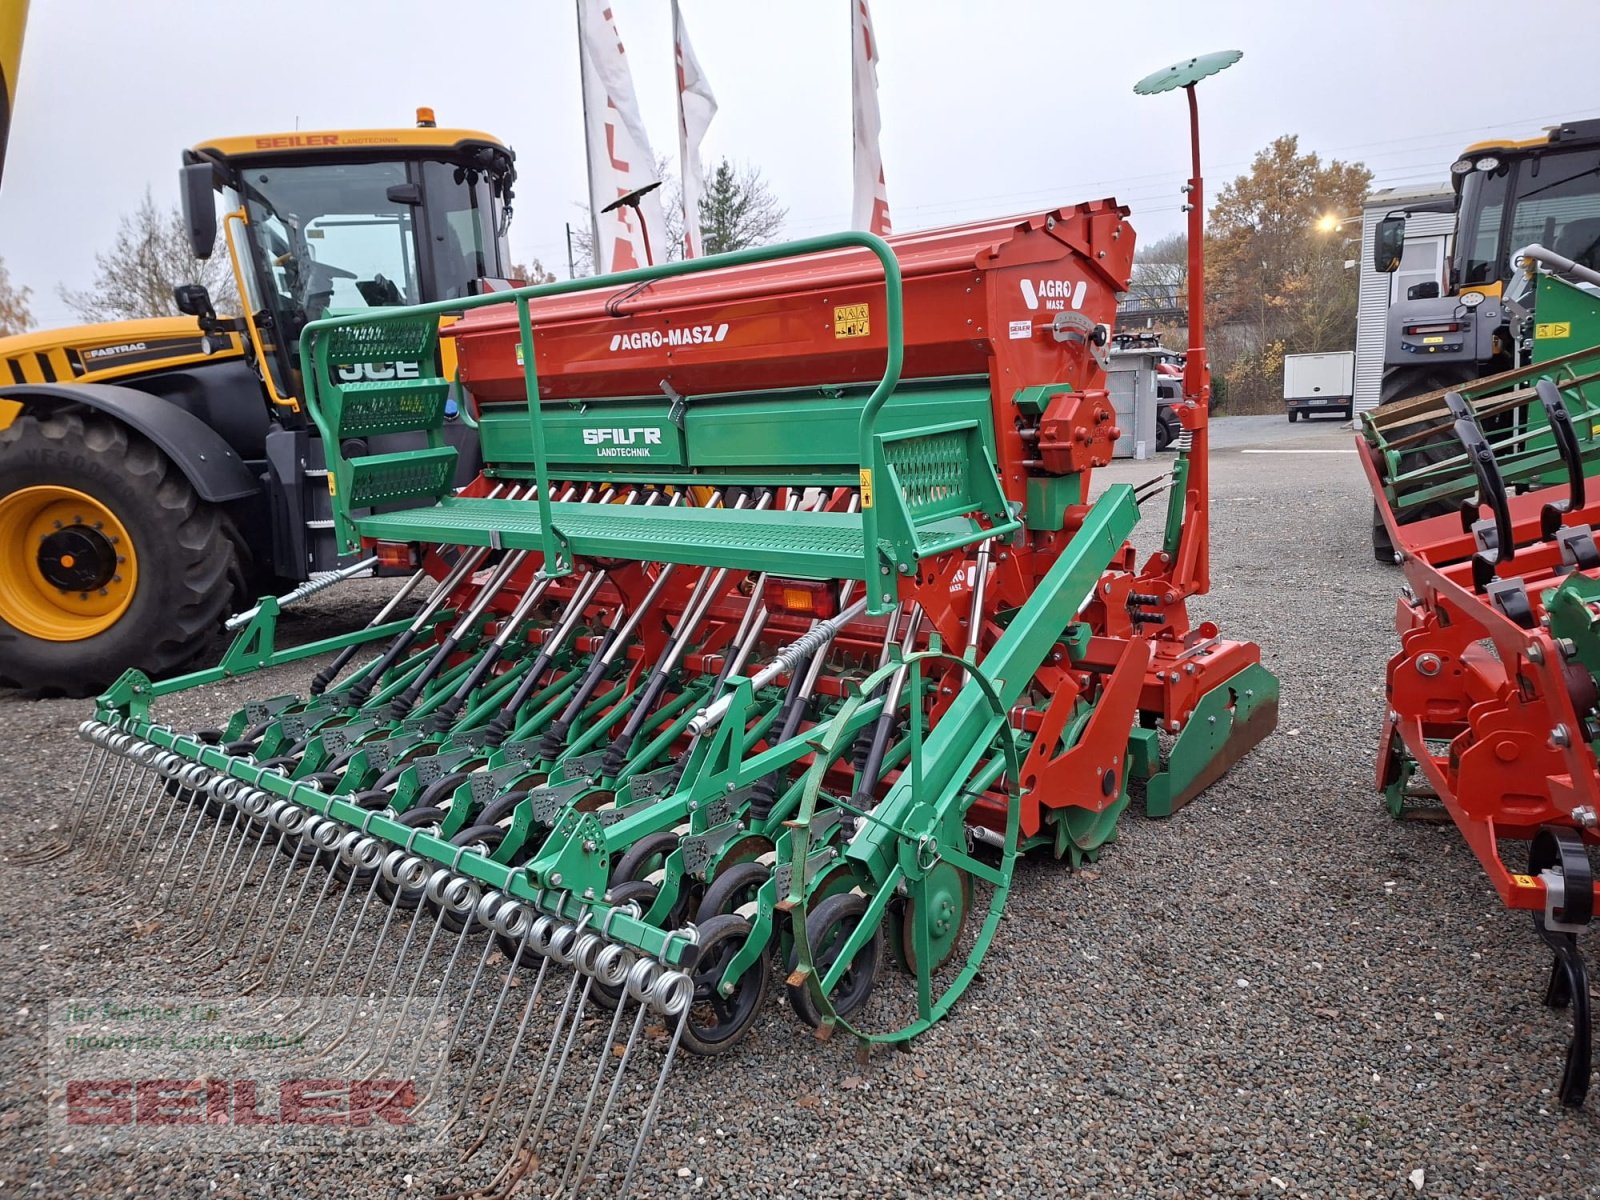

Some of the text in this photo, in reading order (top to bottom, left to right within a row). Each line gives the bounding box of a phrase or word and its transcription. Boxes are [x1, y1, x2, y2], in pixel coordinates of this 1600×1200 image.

[256, 135, 400, 149] SEILER LANDTECHNIK
[1039, 280, 1072, 298] AGRO
[1046, 300, 1065, 310] MASZ
[621, 326, 714, 350] AGRO-MASZ
[91, 342, 147, 358] FASTRAC
[596, 447, 650, 457] LANDTECHNIK
